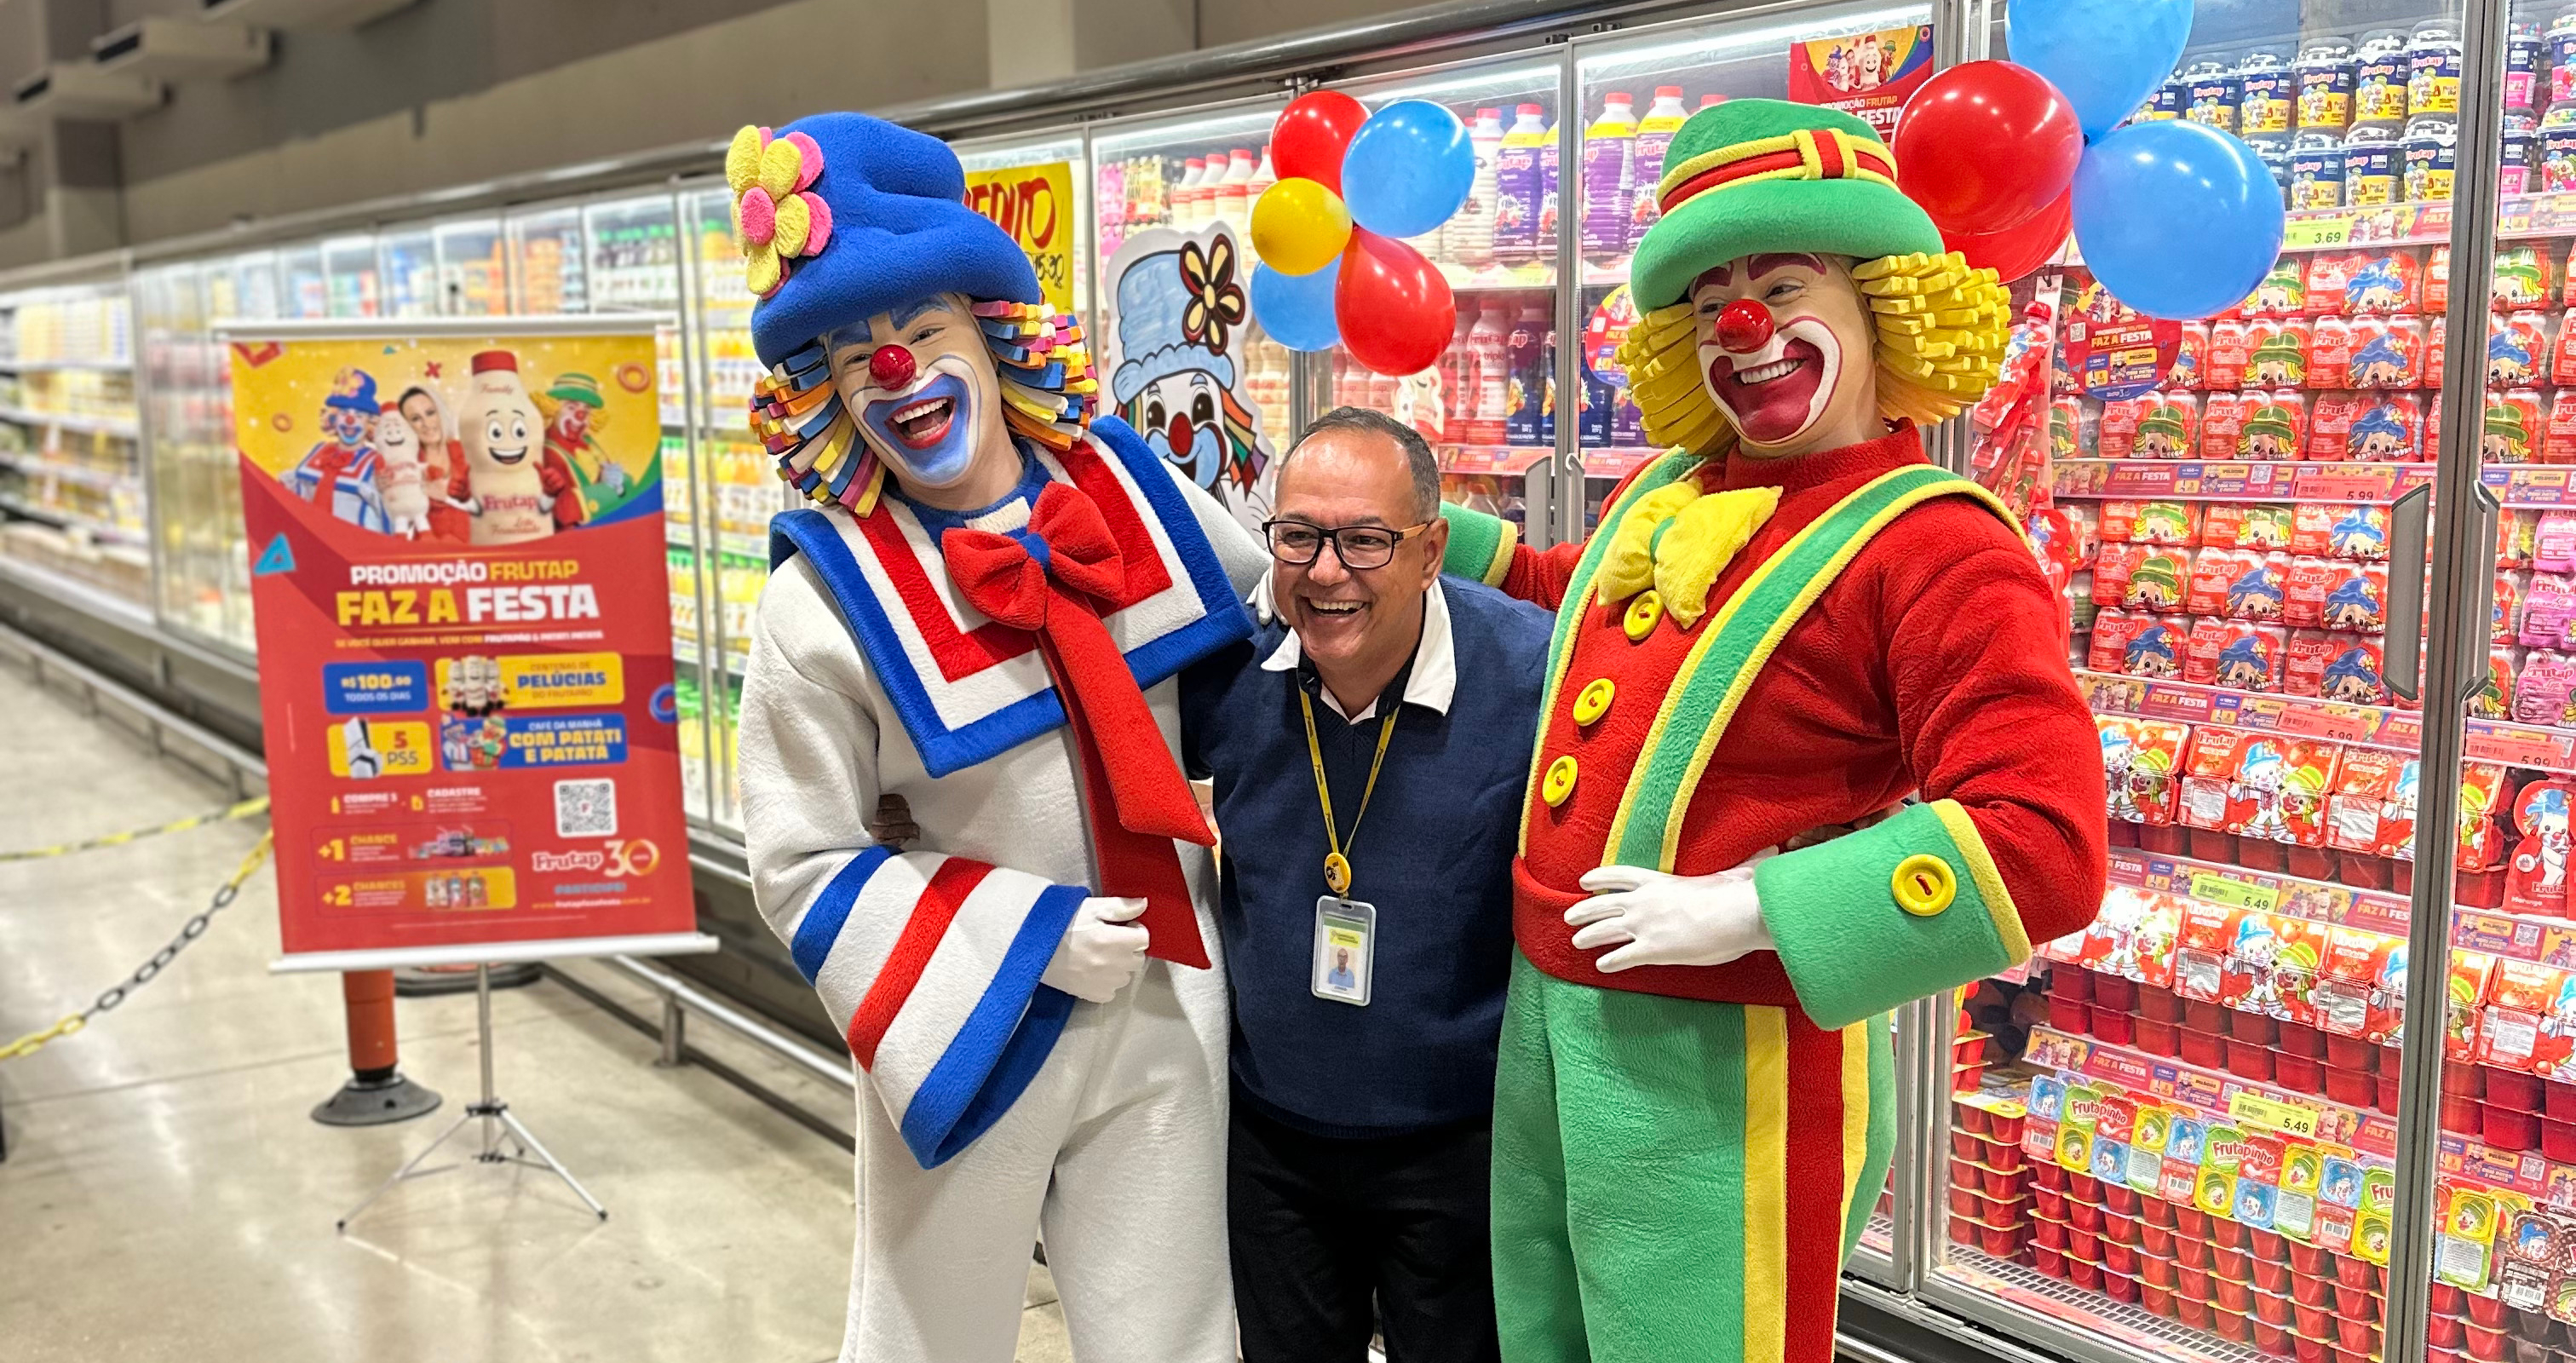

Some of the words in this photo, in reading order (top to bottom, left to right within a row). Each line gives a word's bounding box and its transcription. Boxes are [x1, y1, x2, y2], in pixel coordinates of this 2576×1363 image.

[1866, 95, 1898, 106] FRUTAP
[2091, 336, 2109, 348] FAZ
[2112, 335, 2119, 344] A
[2120, 331, 2153, 343] FESTA
[2113, 472, 2132, 480] FAZ
[2133, 472, 2141, 480] A
[2141, 471, 2171, 480] FESTA
[482, 494, 539, 509] Frutap
[350, 560, 487, 586] PROMOÇÃO
[490, 560, 580, 581] FRUTAP
[2196, 561, 2238, 578] Frutap
[336, 589, 420, 626] FAZ
[428, 588, 460, 624] A
[466, 584, 600, 622] FESTA
[2292, 640, 2334, 655] Frutap
[517, 670, 607, 688] PELÚCIAS
[2527, 666, 2574, 680] Frutap
[344, 692, 376, 703] TODOS
[389, 691, 411, 701] DIAS
[2150, 693, 2171, 704] FAZ
[2171, 695, 2178, 705] A
[2178, 697, 2208, 709] FESTA
[554, 722, 566, 731] DA
[2387, 722, 2407, 733] FAZ
[2408, 725, 2418, 734] A
[394, 730, 408, 750] 5
[509, 731, 555, 748] COM
[559, 728, 622, 746] PATATI
[2198, 731, 2238, 748] Frutap
[387, 750, 419, 766] PS5
[525, 747, 538, 763] E
[343, 793, 389, 803] COMPRE
[427, 786, 481, 798] CADASTRE
[350, 833, 398, 844] CHANCE
[319, 839, 345, 861] +1
[604, 838, 660, 877] 30
[532, 850, 604, 871] Frutap
[2114, 862, 2143, 873] FESTA
[353, 880, 406, 891] CHANCES
[322, 884, 354, 906] +2
[2357, 904, 2378, 915] FAZ
[2379, 906, 2387, 917] A
[2389, 909, 2410, 921] FES
[2092, 1056, 2109, 1068] FAZ
[2109, 1061, 2119, 1071] A
[2119, 1062, 2147, 1078] FESTA
[2070, 1099, 2128, 1124] Frutapinho
[2364, 1127, 2383, 1137] FAZ
[2385, 1130, 2395, 1141] A
[2211, 1141, 2274, 1166] Frutapinho
